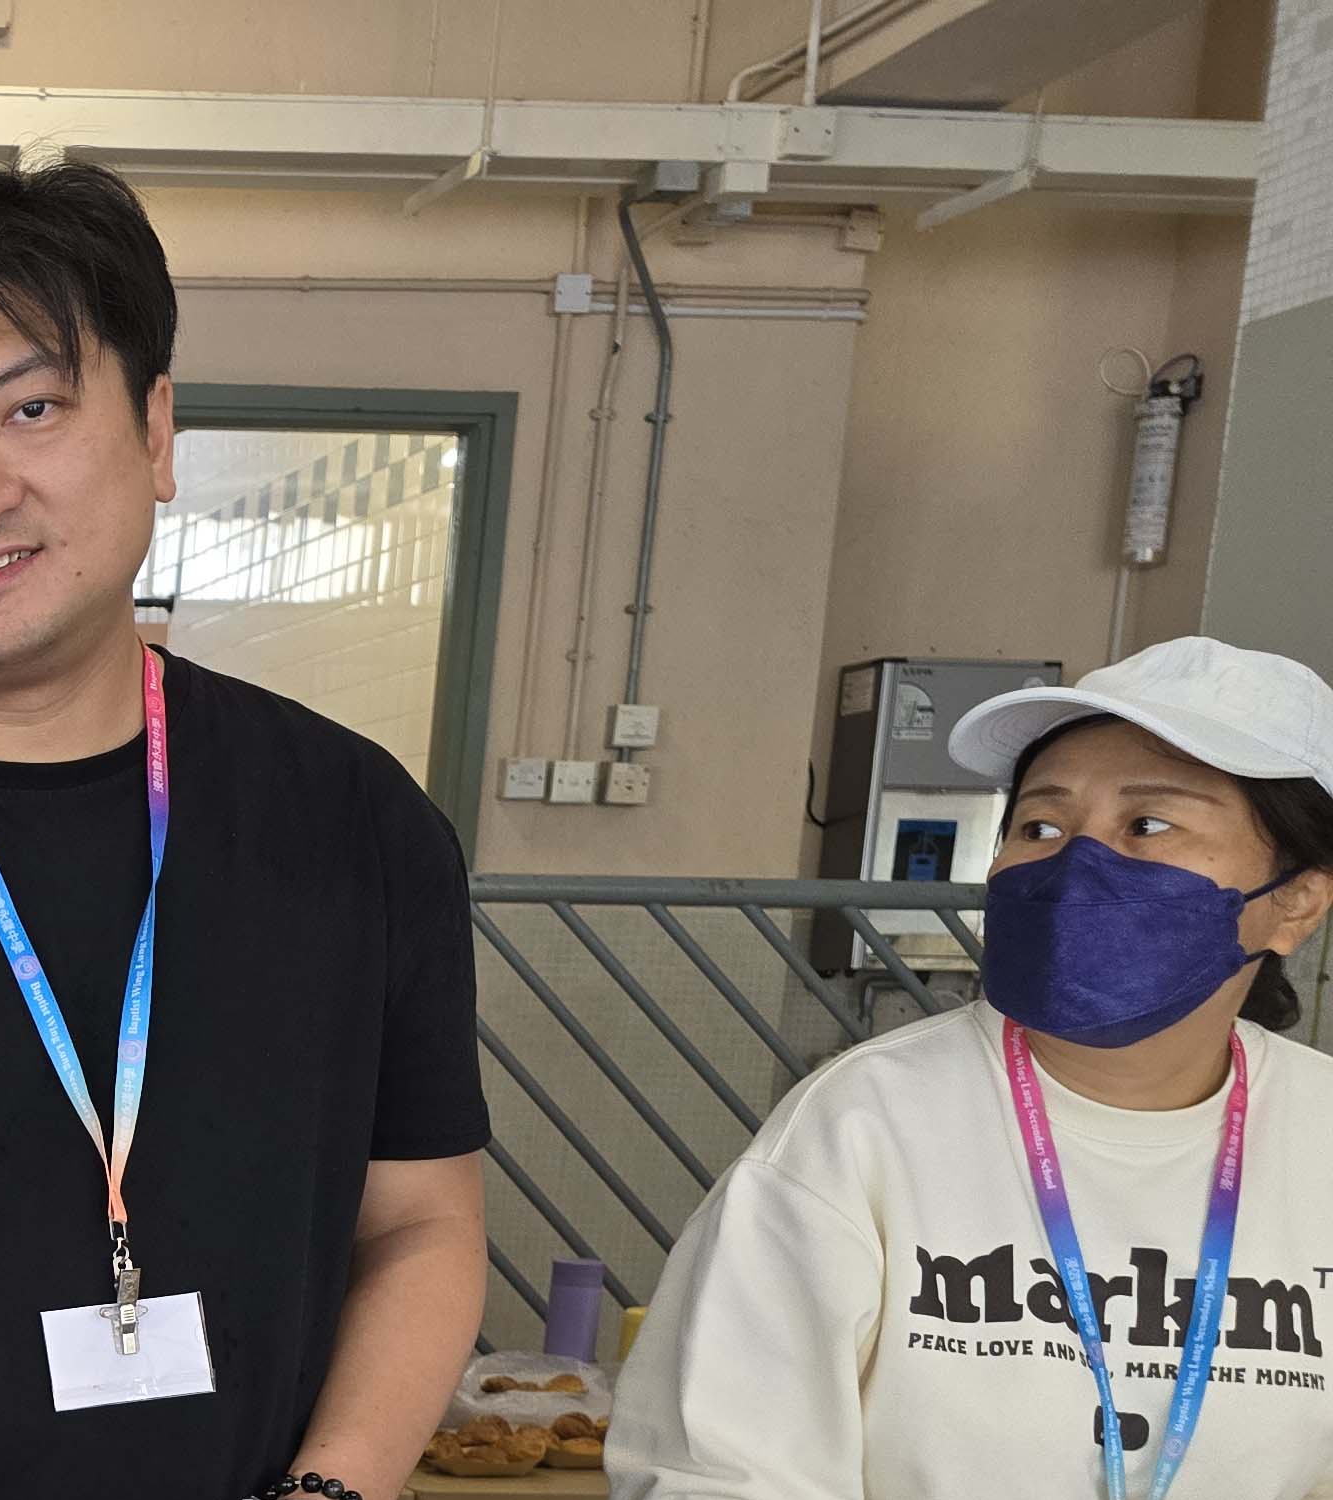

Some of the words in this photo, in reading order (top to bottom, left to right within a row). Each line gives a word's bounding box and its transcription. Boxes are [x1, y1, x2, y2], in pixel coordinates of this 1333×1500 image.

[30, 981, 50, 1017] Baptist
[45, 1015, 61, 1046] Wing
[57, 1043, 73, 1073] Lung
[1026, 1106, 1046, 1157] Secondary
[1039, 1157, 1057, 1191] School
[908, 1332, 967, 1355] PEACE
[977, 1339, 1034, 1357] LOVE
[1044, 1341, 1076, 1363] AND
[1125, 1361, 1183, 1382] MAR
[1207, 1366, 1246, 1384] THE
[1256, 1369, 1326, 1391] MOMENT
